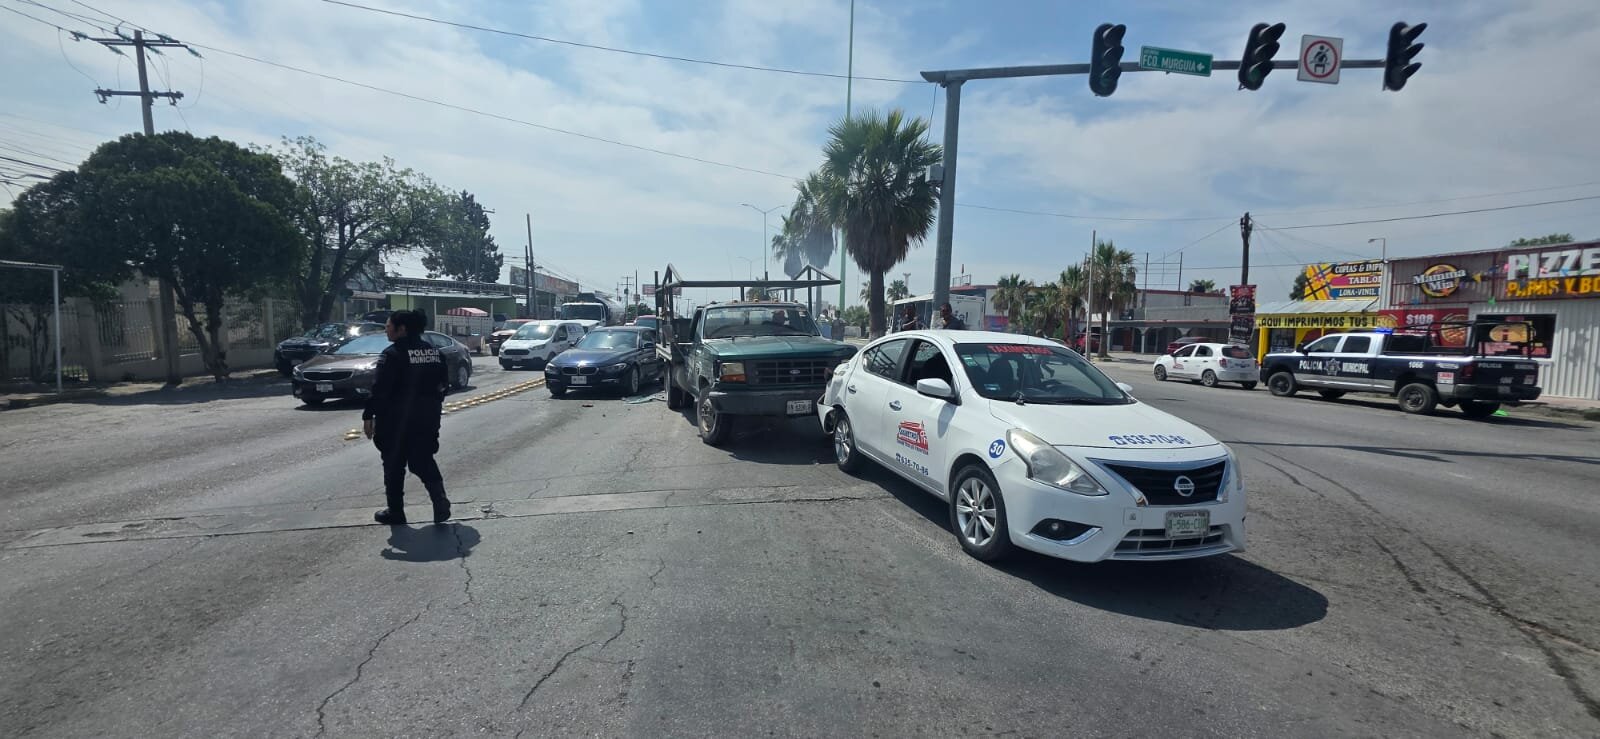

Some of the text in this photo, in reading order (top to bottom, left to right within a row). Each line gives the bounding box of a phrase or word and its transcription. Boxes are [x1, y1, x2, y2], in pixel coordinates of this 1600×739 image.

[1161, 57, 1196, 72] MURGUIA
[1413, 269, 1466, 285] Mamma
[1430, 280, 1453, 291] Mia
[1284, 316, 1345, 327] IMPRIMIMOS
[1349, 316, 1368, 327] TUS
[408, 349, 440, 357] POLICIA
[409, 355, 441, 364] MUNICIPAL
[1299, 360, 1323, 371] POLICIA
[990, 443, 1003, 456] 30
